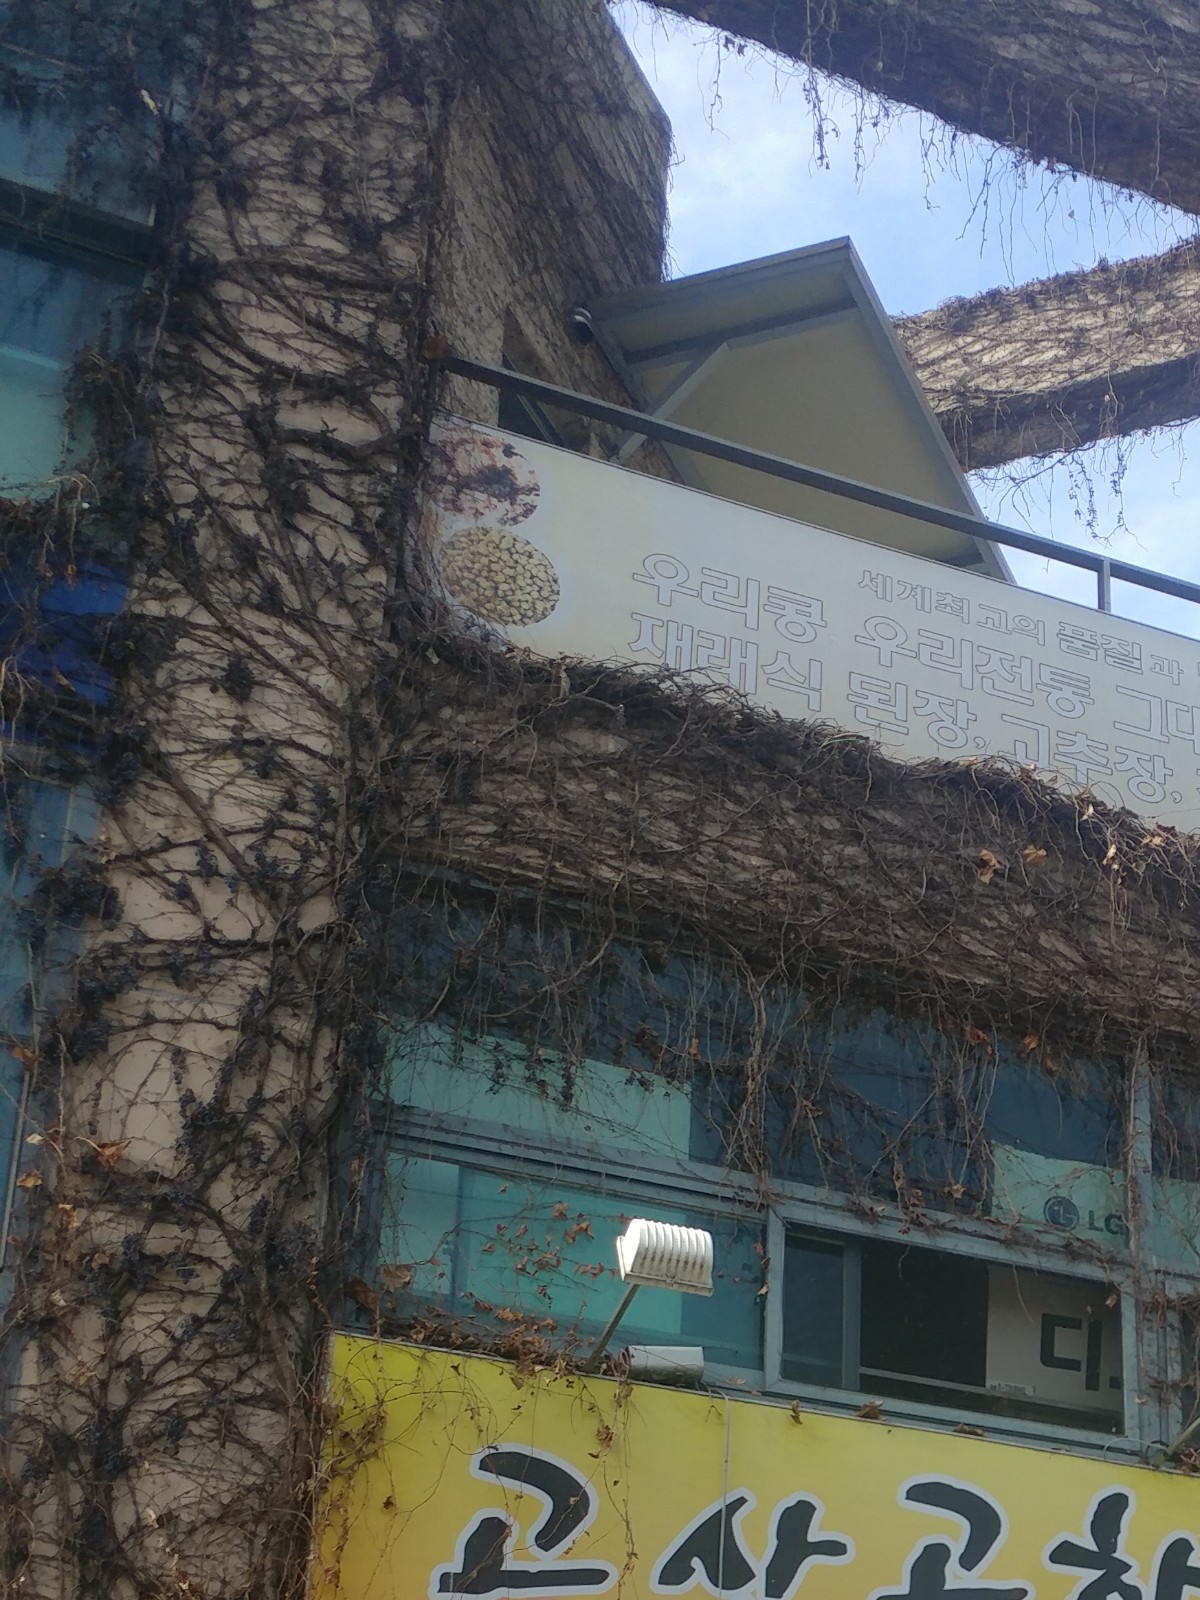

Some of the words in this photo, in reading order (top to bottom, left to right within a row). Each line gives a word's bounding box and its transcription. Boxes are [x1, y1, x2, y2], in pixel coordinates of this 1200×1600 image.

[628, 612, 823, 712] 재래식
[847, 671, 986, 749] 된장,
[632, 553, 827, 643] 우리콩
[855, 615, 1094, 719] 우리전통
[858, 569, 1046, 646] 세계최고의
[1057, 621, 1184, 685] 품질과
